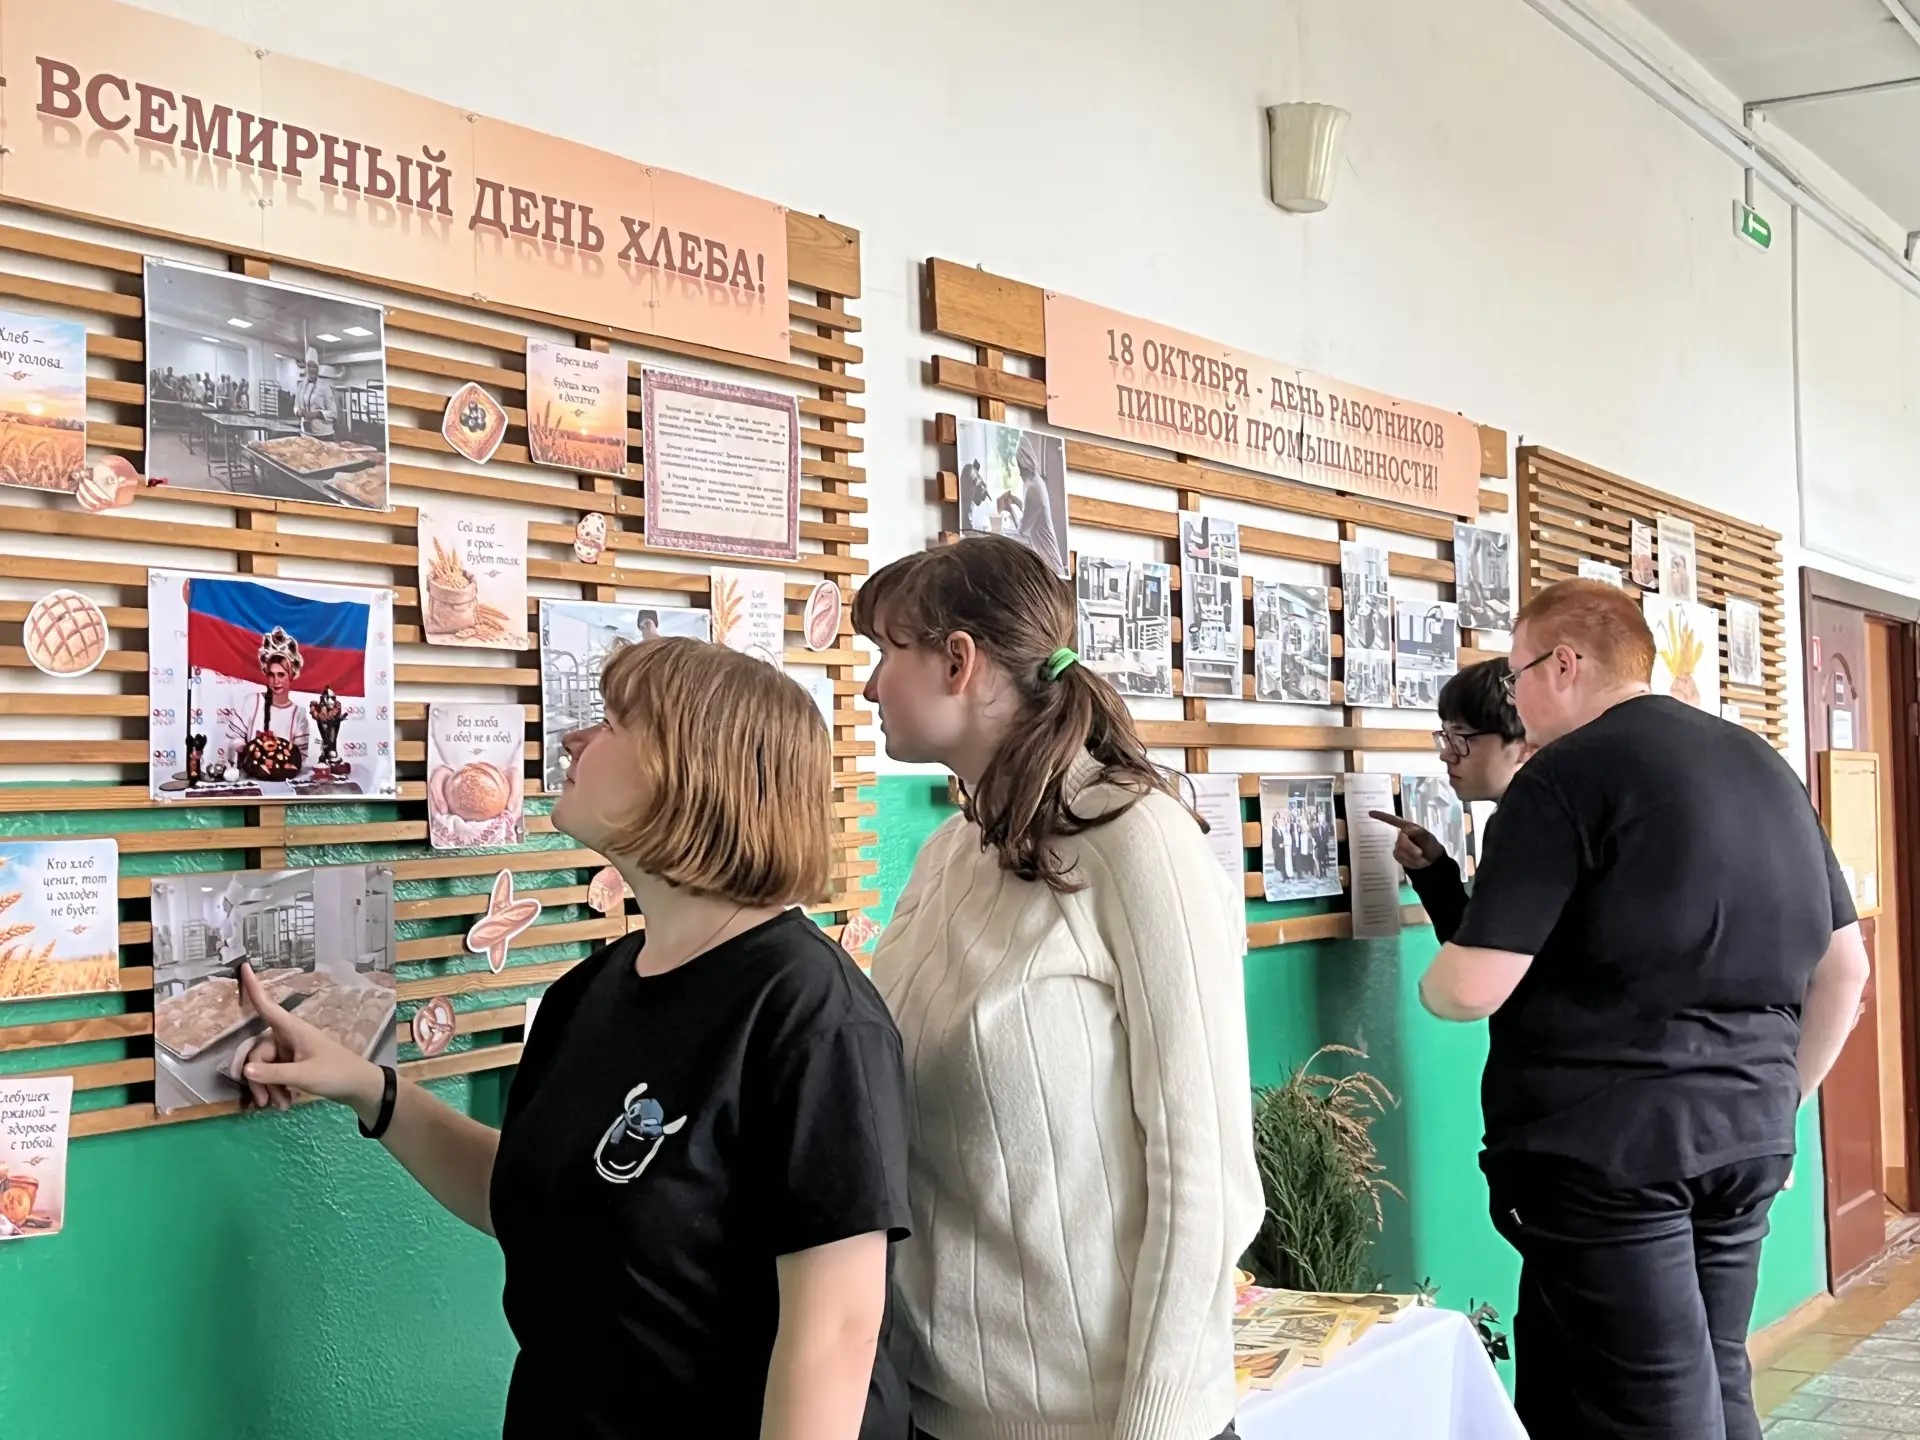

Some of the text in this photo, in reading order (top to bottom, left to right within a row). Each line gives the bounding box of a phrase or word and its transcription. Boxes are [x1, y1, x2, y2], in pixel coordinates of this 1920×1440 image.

[36, 56, 765, 294] ВСЕМИРНЫЙ ДЕНЬ ХЛЕБА!
[18, 353, 64, 369] голова.
[555, 353, 599, 369] Береги хлеб
[554, 376, 600, 394] будешь жить
[1107, 329, 1134, 366] 18
[1143, 339, 1250, 398] ОКТЯБРЯ
[1271, 377, 1324, 418] ДЕНЬ
[1328, 393, 1444, 449] РАБОТНИКОВ
[1116, 384, 1438, 490] ПИЩЕВОЙ ПРОМЫШЛЕННОСТИ!
[457, 520, 495, 535] Сей хлеб
[474, 540, 494, 552] срок
[467, 551, 494, 565] будет
[457, 715, 498, 728] Без хлеба
[453, 731, 472, 743] обед
[474, 734, 483, 742] не
[47, 856, 95, 870] Кто хлеб
[43, 875, 107, 887] ценит, тот
[46, 888, 98, 901] и голоден
[51, 903, 98, 918] не будет.
[0, 1090, 50, 1106] лебушек
[0, 1106, 46, 1123] ржаной
[7, 1122, 57, 1137] здоровье
[10, 1136, 54, 1150] с тобой.
